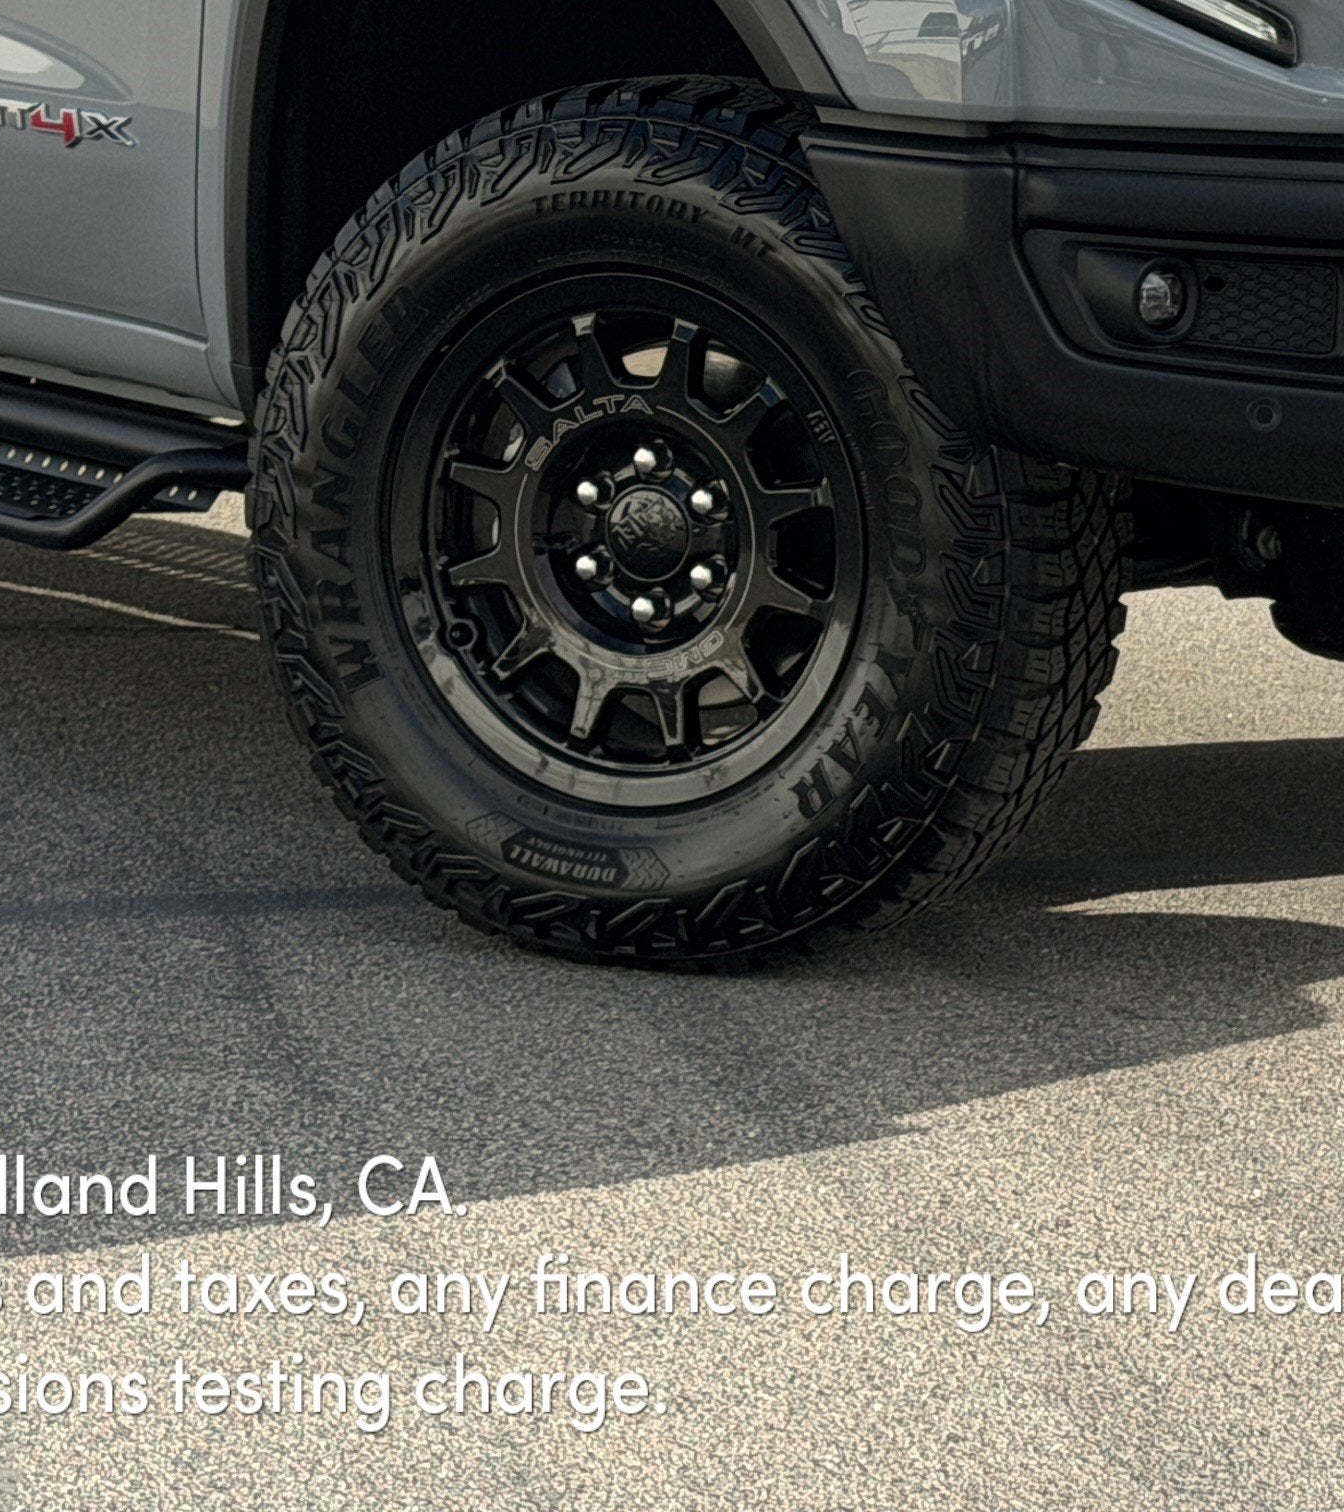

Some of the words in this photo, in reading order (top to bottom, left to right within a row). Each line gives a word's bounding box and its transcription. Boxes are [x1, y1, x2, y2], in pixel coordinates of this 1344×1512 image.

[531, 189, 709, 224] TERRITORY
[524, 393, 655, 472] SALTA
[310, 284, 431, 694] WRANGLER
[509, 844, 617, 883] DURAWALL
